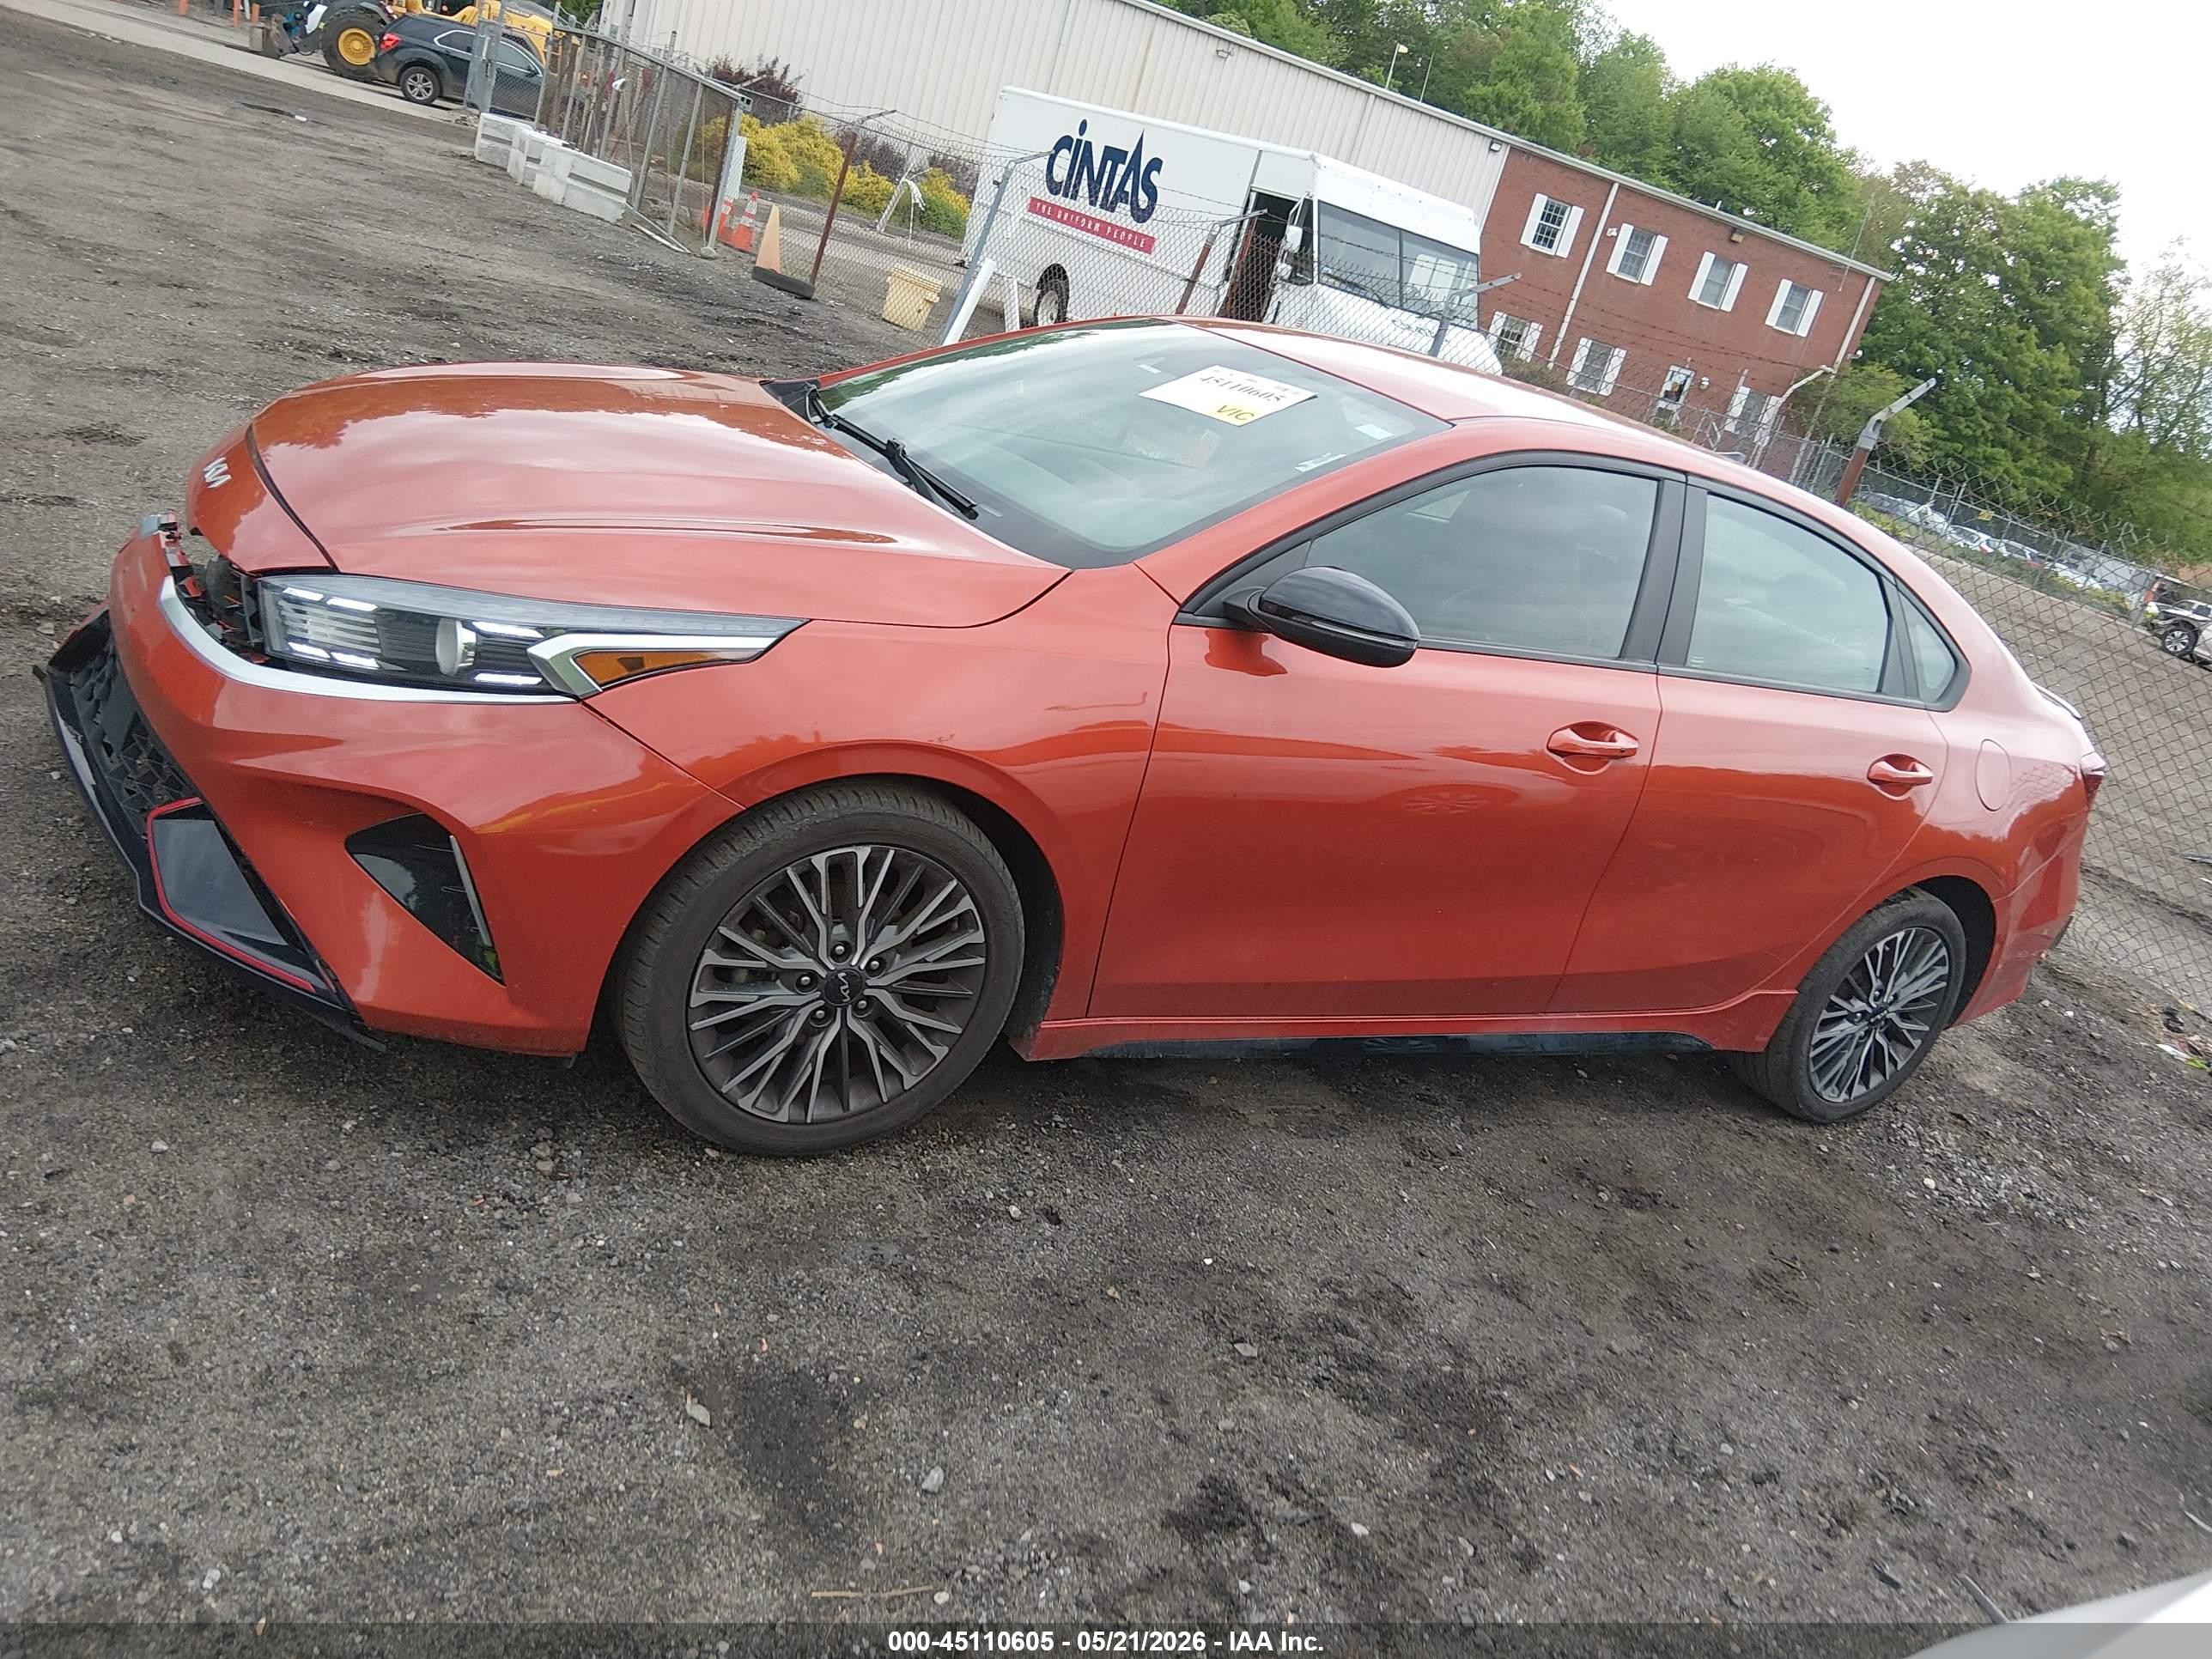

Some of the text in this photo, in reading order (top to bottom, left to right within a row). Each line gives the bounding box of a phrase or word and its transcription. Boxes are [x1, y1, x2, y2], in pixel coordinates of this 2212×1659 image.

[1036, 202, 1146, 248] THE UNIFORM PEOPLE
[1216, 404, 1255, 421] VIC
